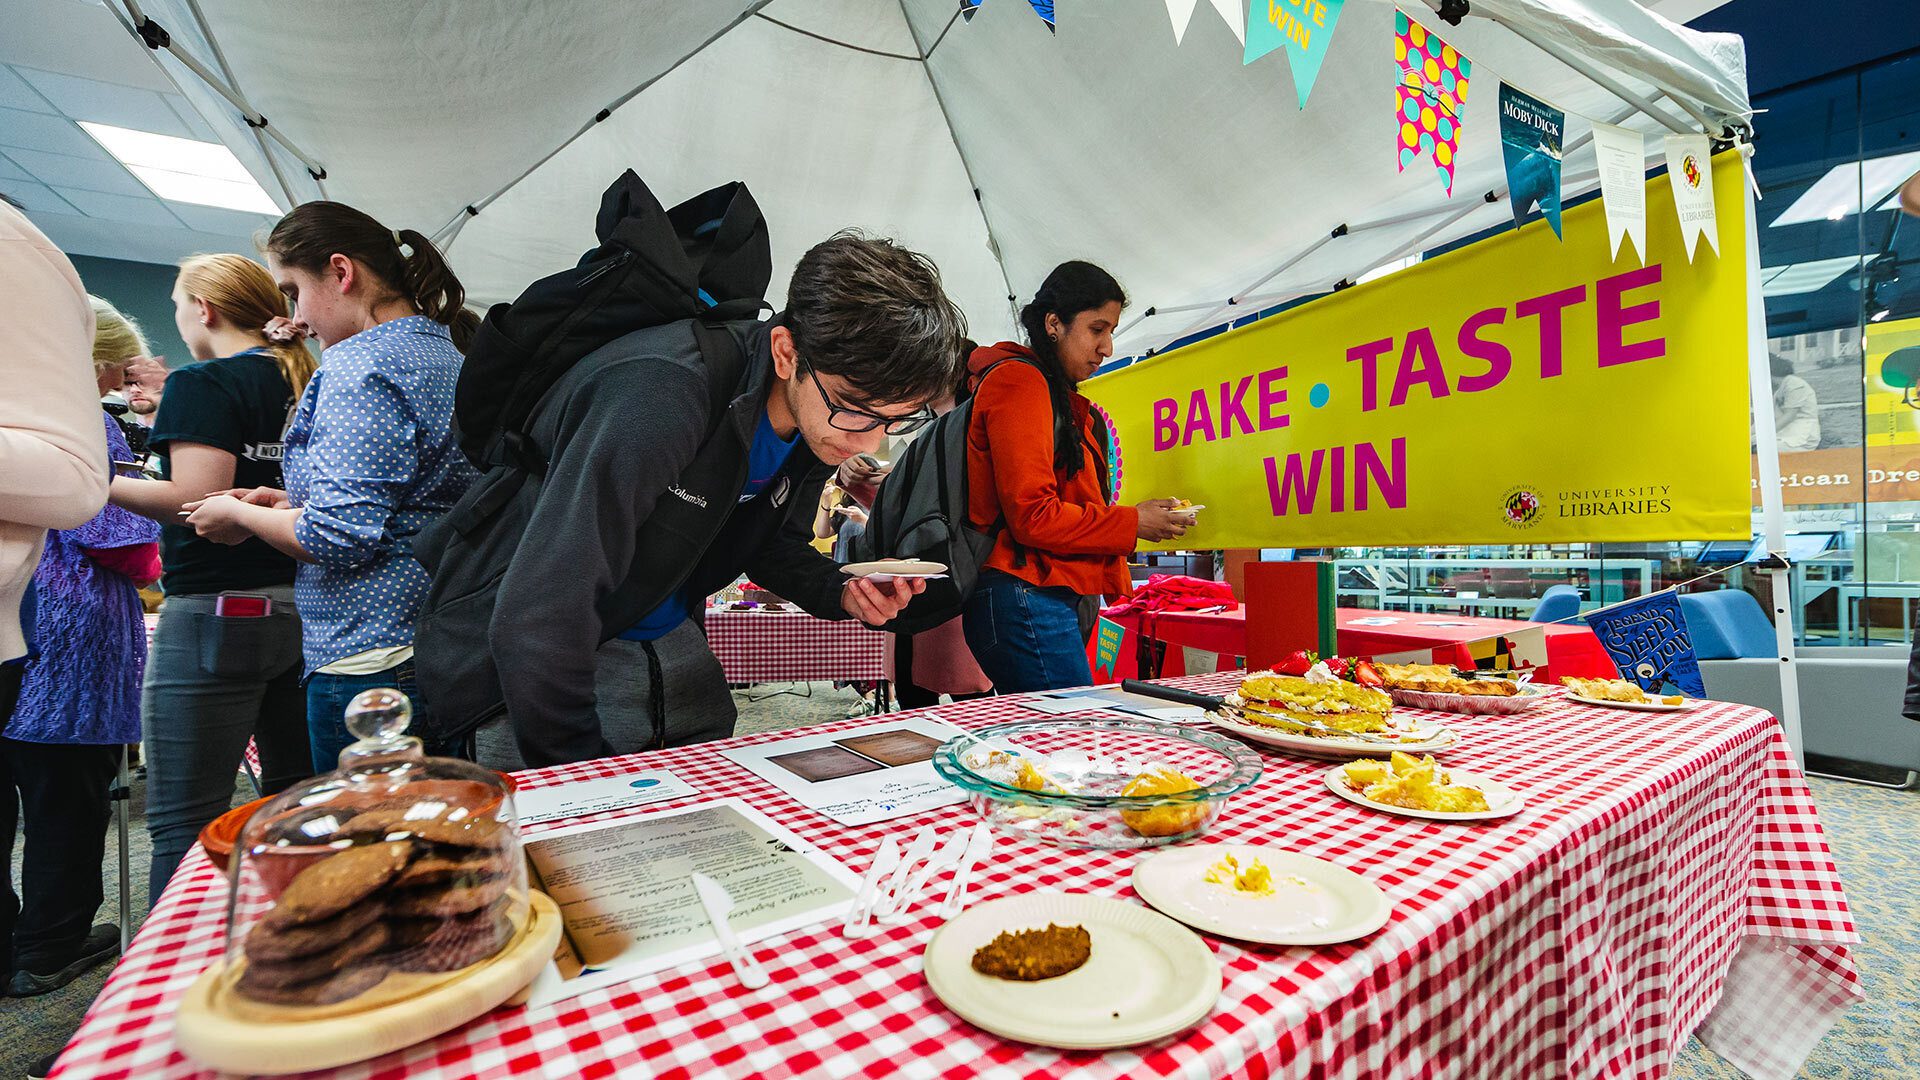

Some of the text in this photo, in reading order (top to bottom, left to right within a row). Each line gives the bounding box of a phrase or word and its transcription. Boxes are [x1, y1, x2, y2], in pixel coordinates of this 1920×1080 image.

[1268, 0, 1311, 51] WIN
[1503, 100, 1559, 136] MOBY DICK
[1682, 209, 1714, 222] LIBRARIES
[1154, 266, 1665, 451] BAKE TASTE
[1264, 438, 1406, 515] WIN
[667, 483, 707, 509] Columbia
[1559, 485, 1671, 501] UNIVERSITY
[1560, 499, 1672, 518] LIBRARIES
[1103, 628, 1119, 641] BAKE
[1605, 608, 1660, 637] LEGEND
[1100, 638, 1117, 653] TASTE
[1606, 608, 1681, 668] SLEEPY
[1101, 650, 1112, 662] WIN
